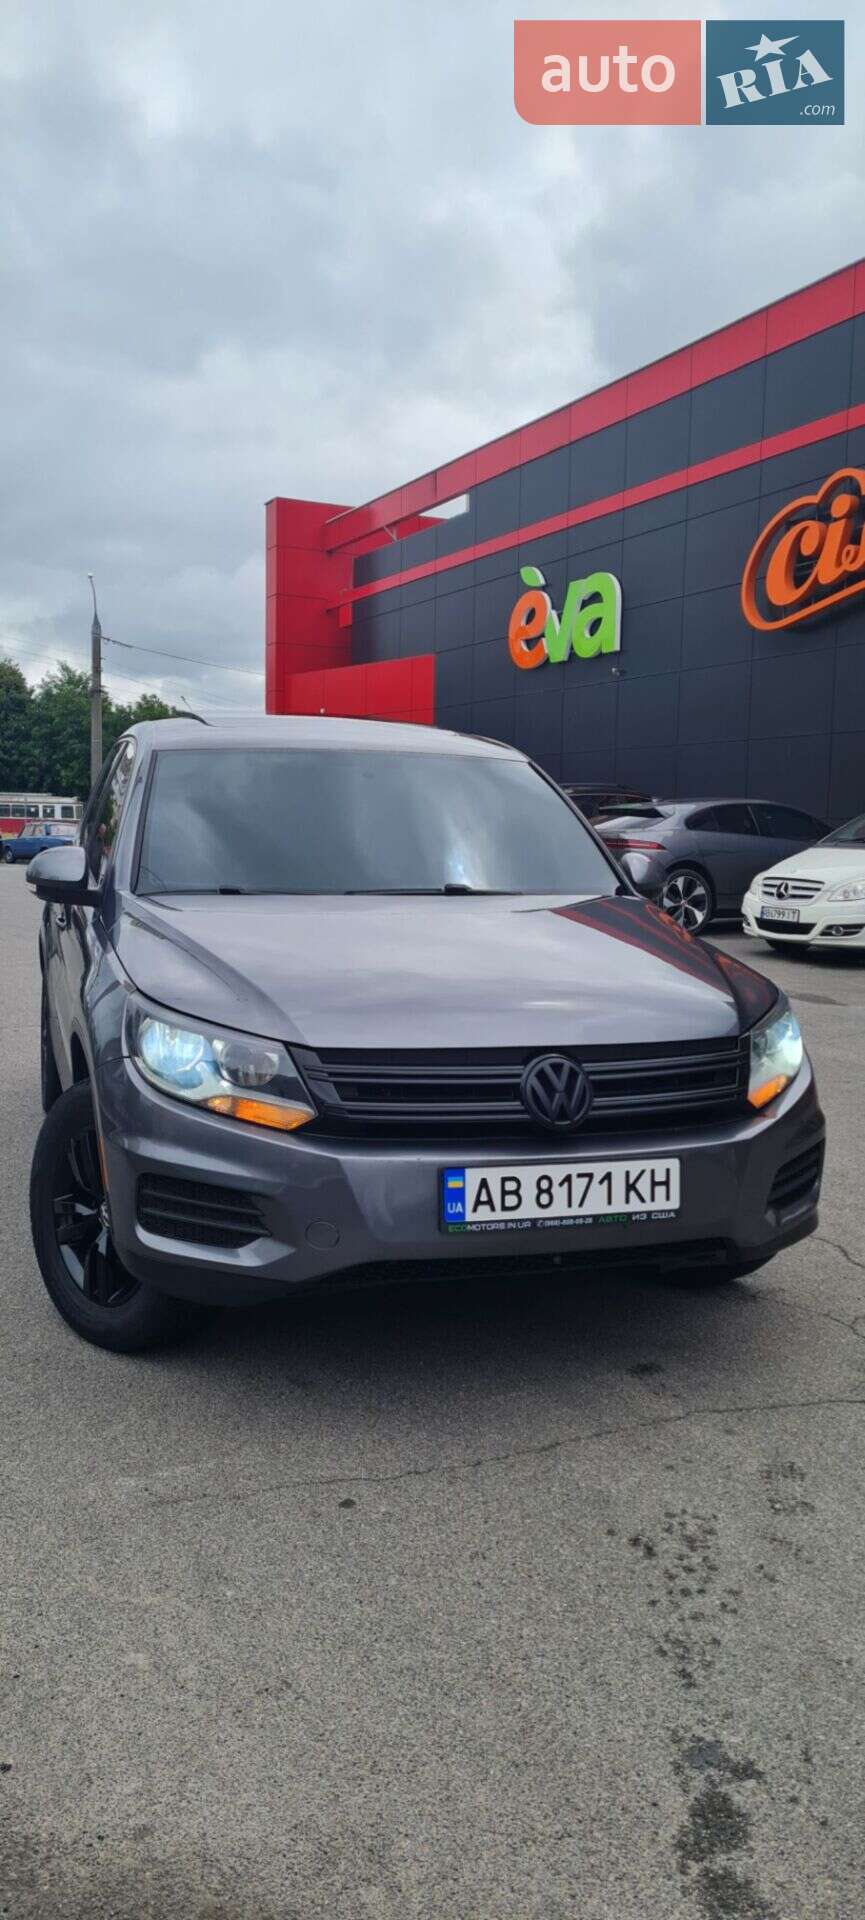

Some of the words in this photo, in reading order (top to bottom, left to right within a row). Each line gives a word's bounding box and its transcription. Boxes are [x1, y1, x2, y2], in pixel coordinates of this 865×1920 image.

[471, 1176, 523, 1213] AB
[535, 1171, 613, 1210] 8171
[624, 1167, 671, 1204] KH
[447, 1202, 463, 1214] UA
